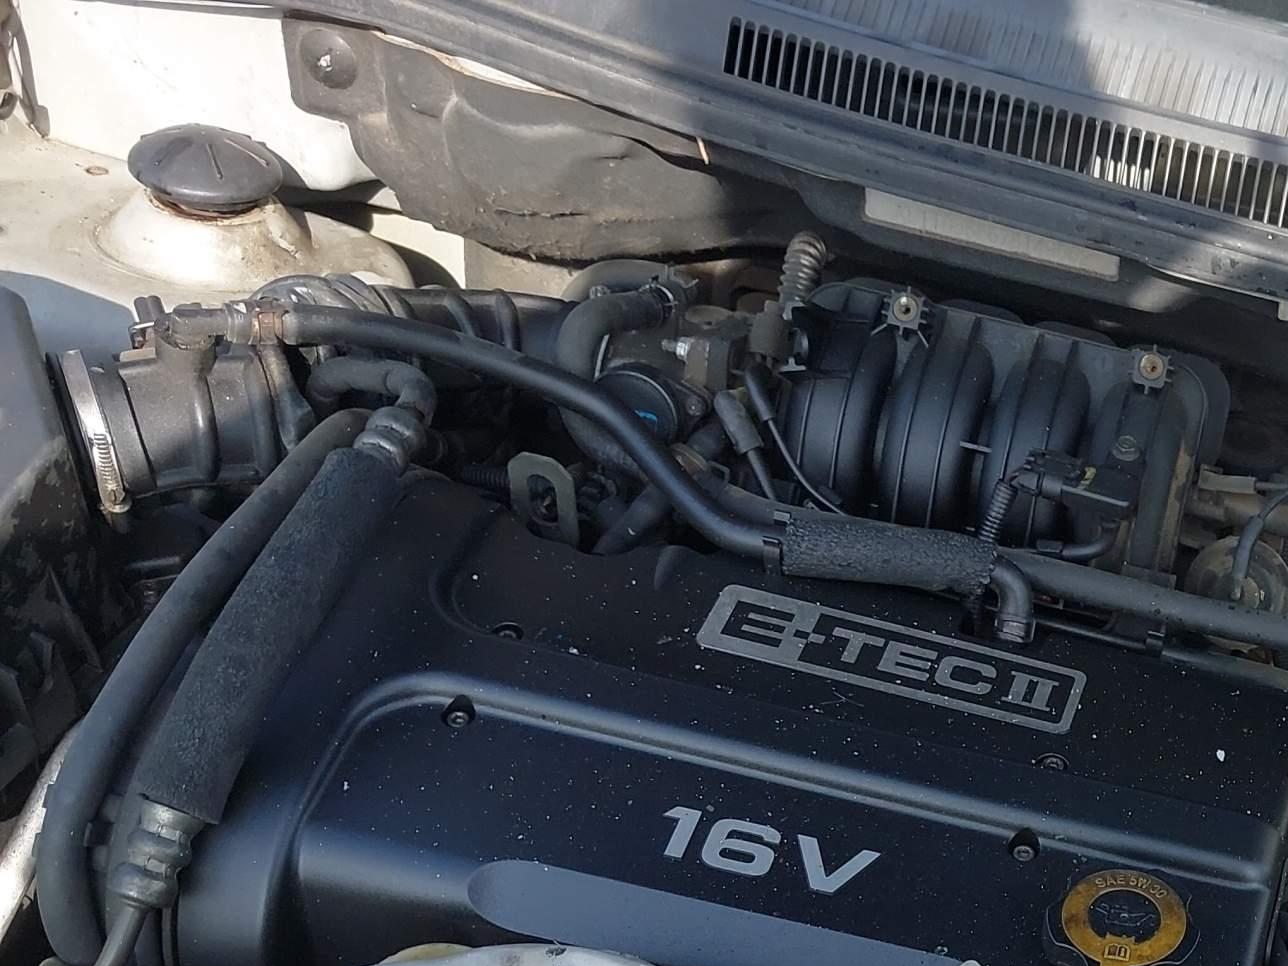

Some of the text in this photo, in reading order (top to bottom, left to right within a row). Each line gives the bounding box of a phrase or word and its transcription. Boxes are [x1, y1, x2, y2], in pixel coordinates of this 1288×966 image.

[719, 600, 997, 696] E-TEC
[663, 805, 882, 894] 16V
[1095, 874, 1125, 889] SAE
